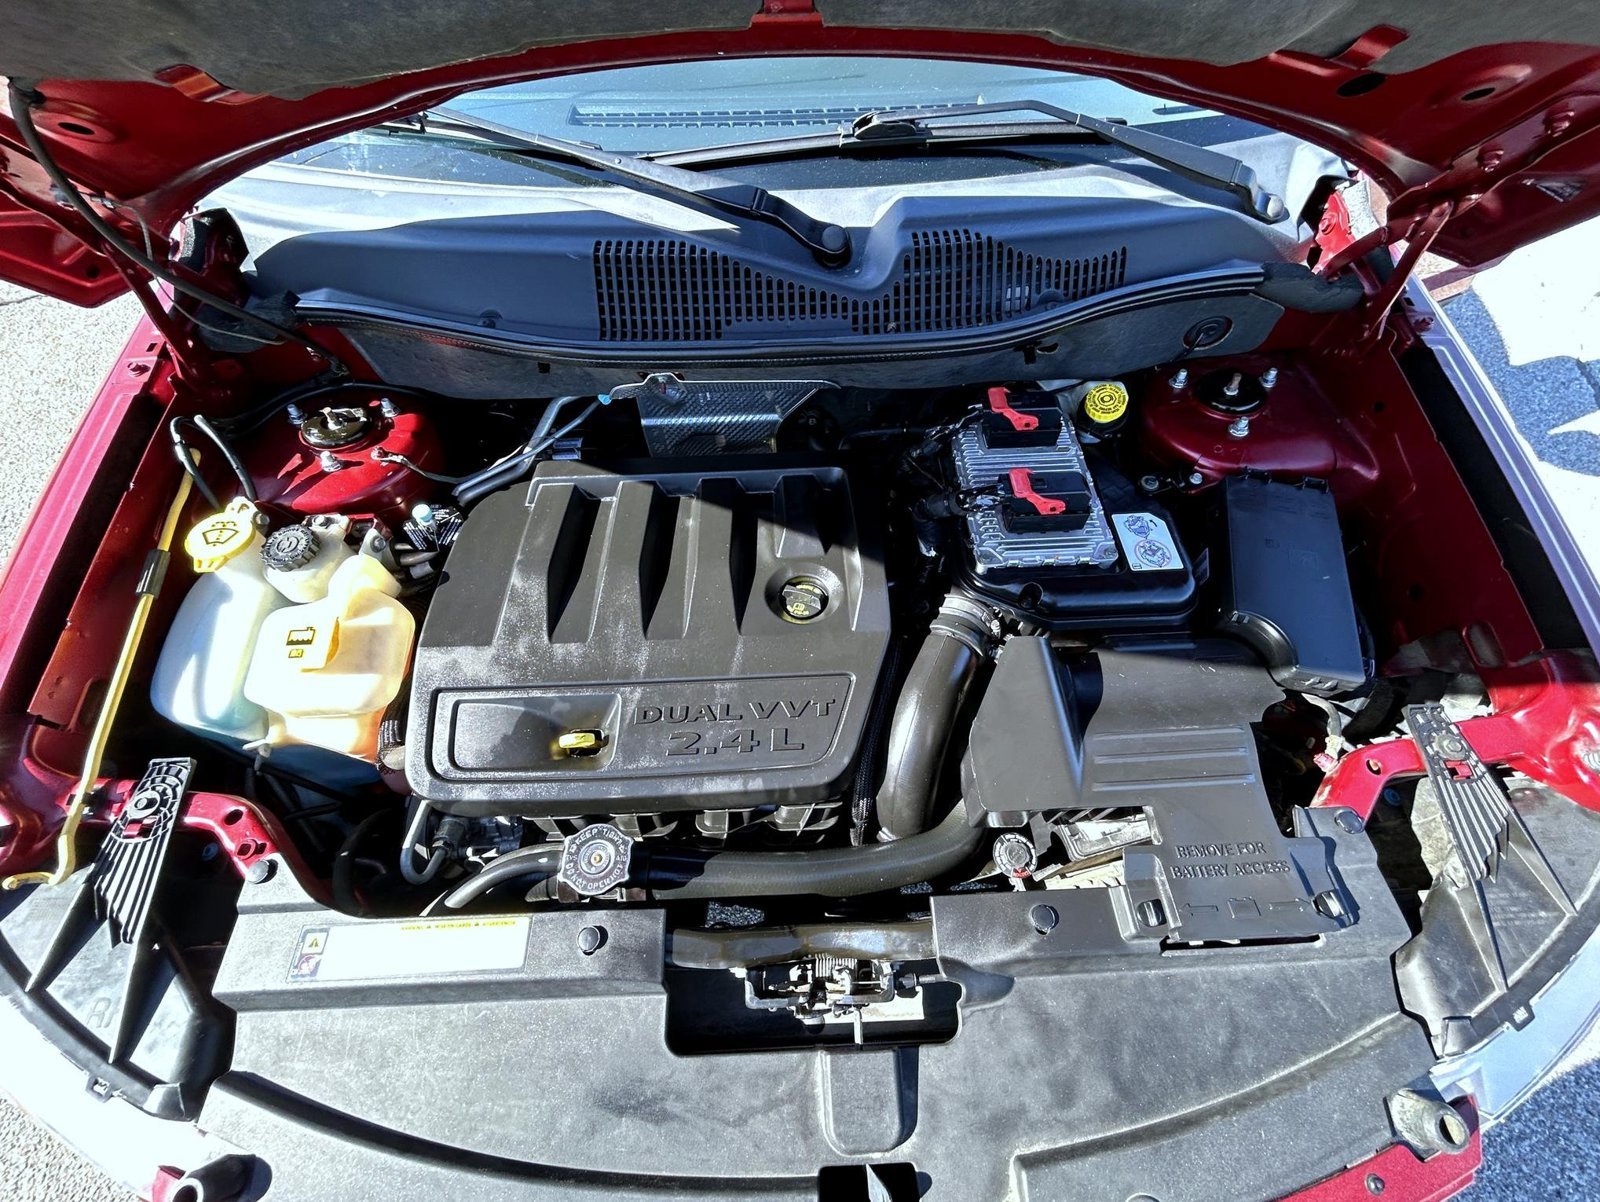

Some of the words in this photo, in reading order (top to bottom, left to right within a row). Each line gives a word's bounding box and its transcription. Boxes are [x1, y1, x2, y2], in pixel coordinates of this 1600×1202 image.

[634, 703, 743, 725] DUAL
[749, 698, 836, 720] VVT
[575, 828, 599, 845] KEEP
[602, 828, 623, 847] TIGHT
[1174, 843, 1235, 859] REMOVE
[1235, 841, 1267, 856] FOR
[1170, 863, 1229, 879] BATTERY
[1234, 860, 1291, 876] ACCESS
